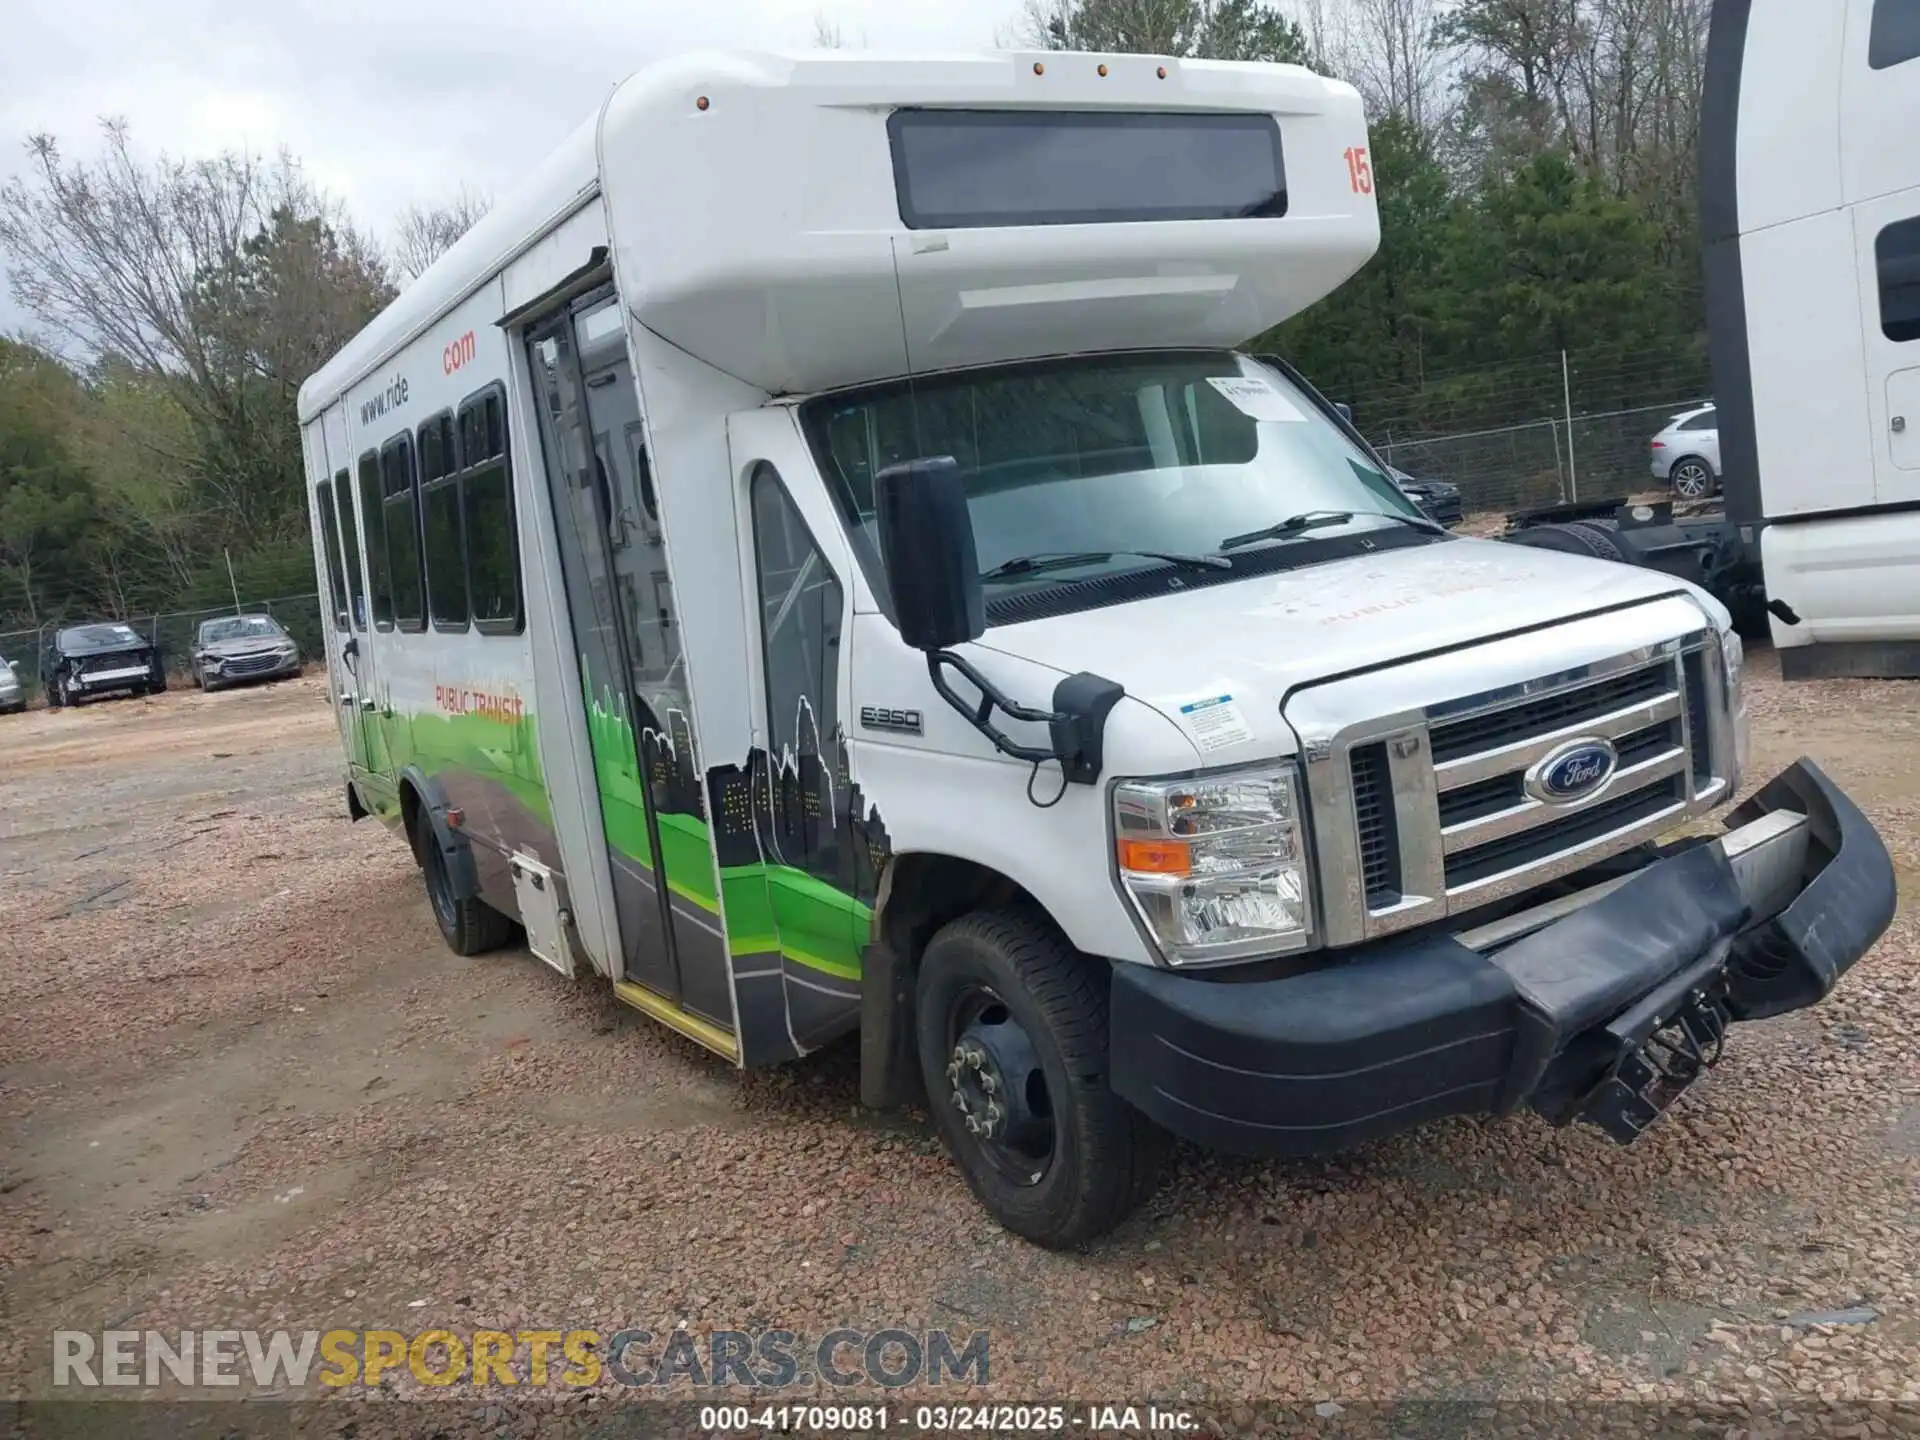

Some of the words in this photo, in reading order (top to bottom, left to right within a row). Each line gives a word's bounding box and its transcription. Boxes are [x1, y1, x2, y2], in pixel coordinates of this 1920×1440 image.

[1343, 146, 1372, 194] 15
[360, 372, 409, 427] www.ride
[443, 330, 477, 376] com
[435, 685, 469, 715] PUBLIC
[473, 692, 524, 725] TRANSIT
[1563, 755, 1601, 786] Ford
